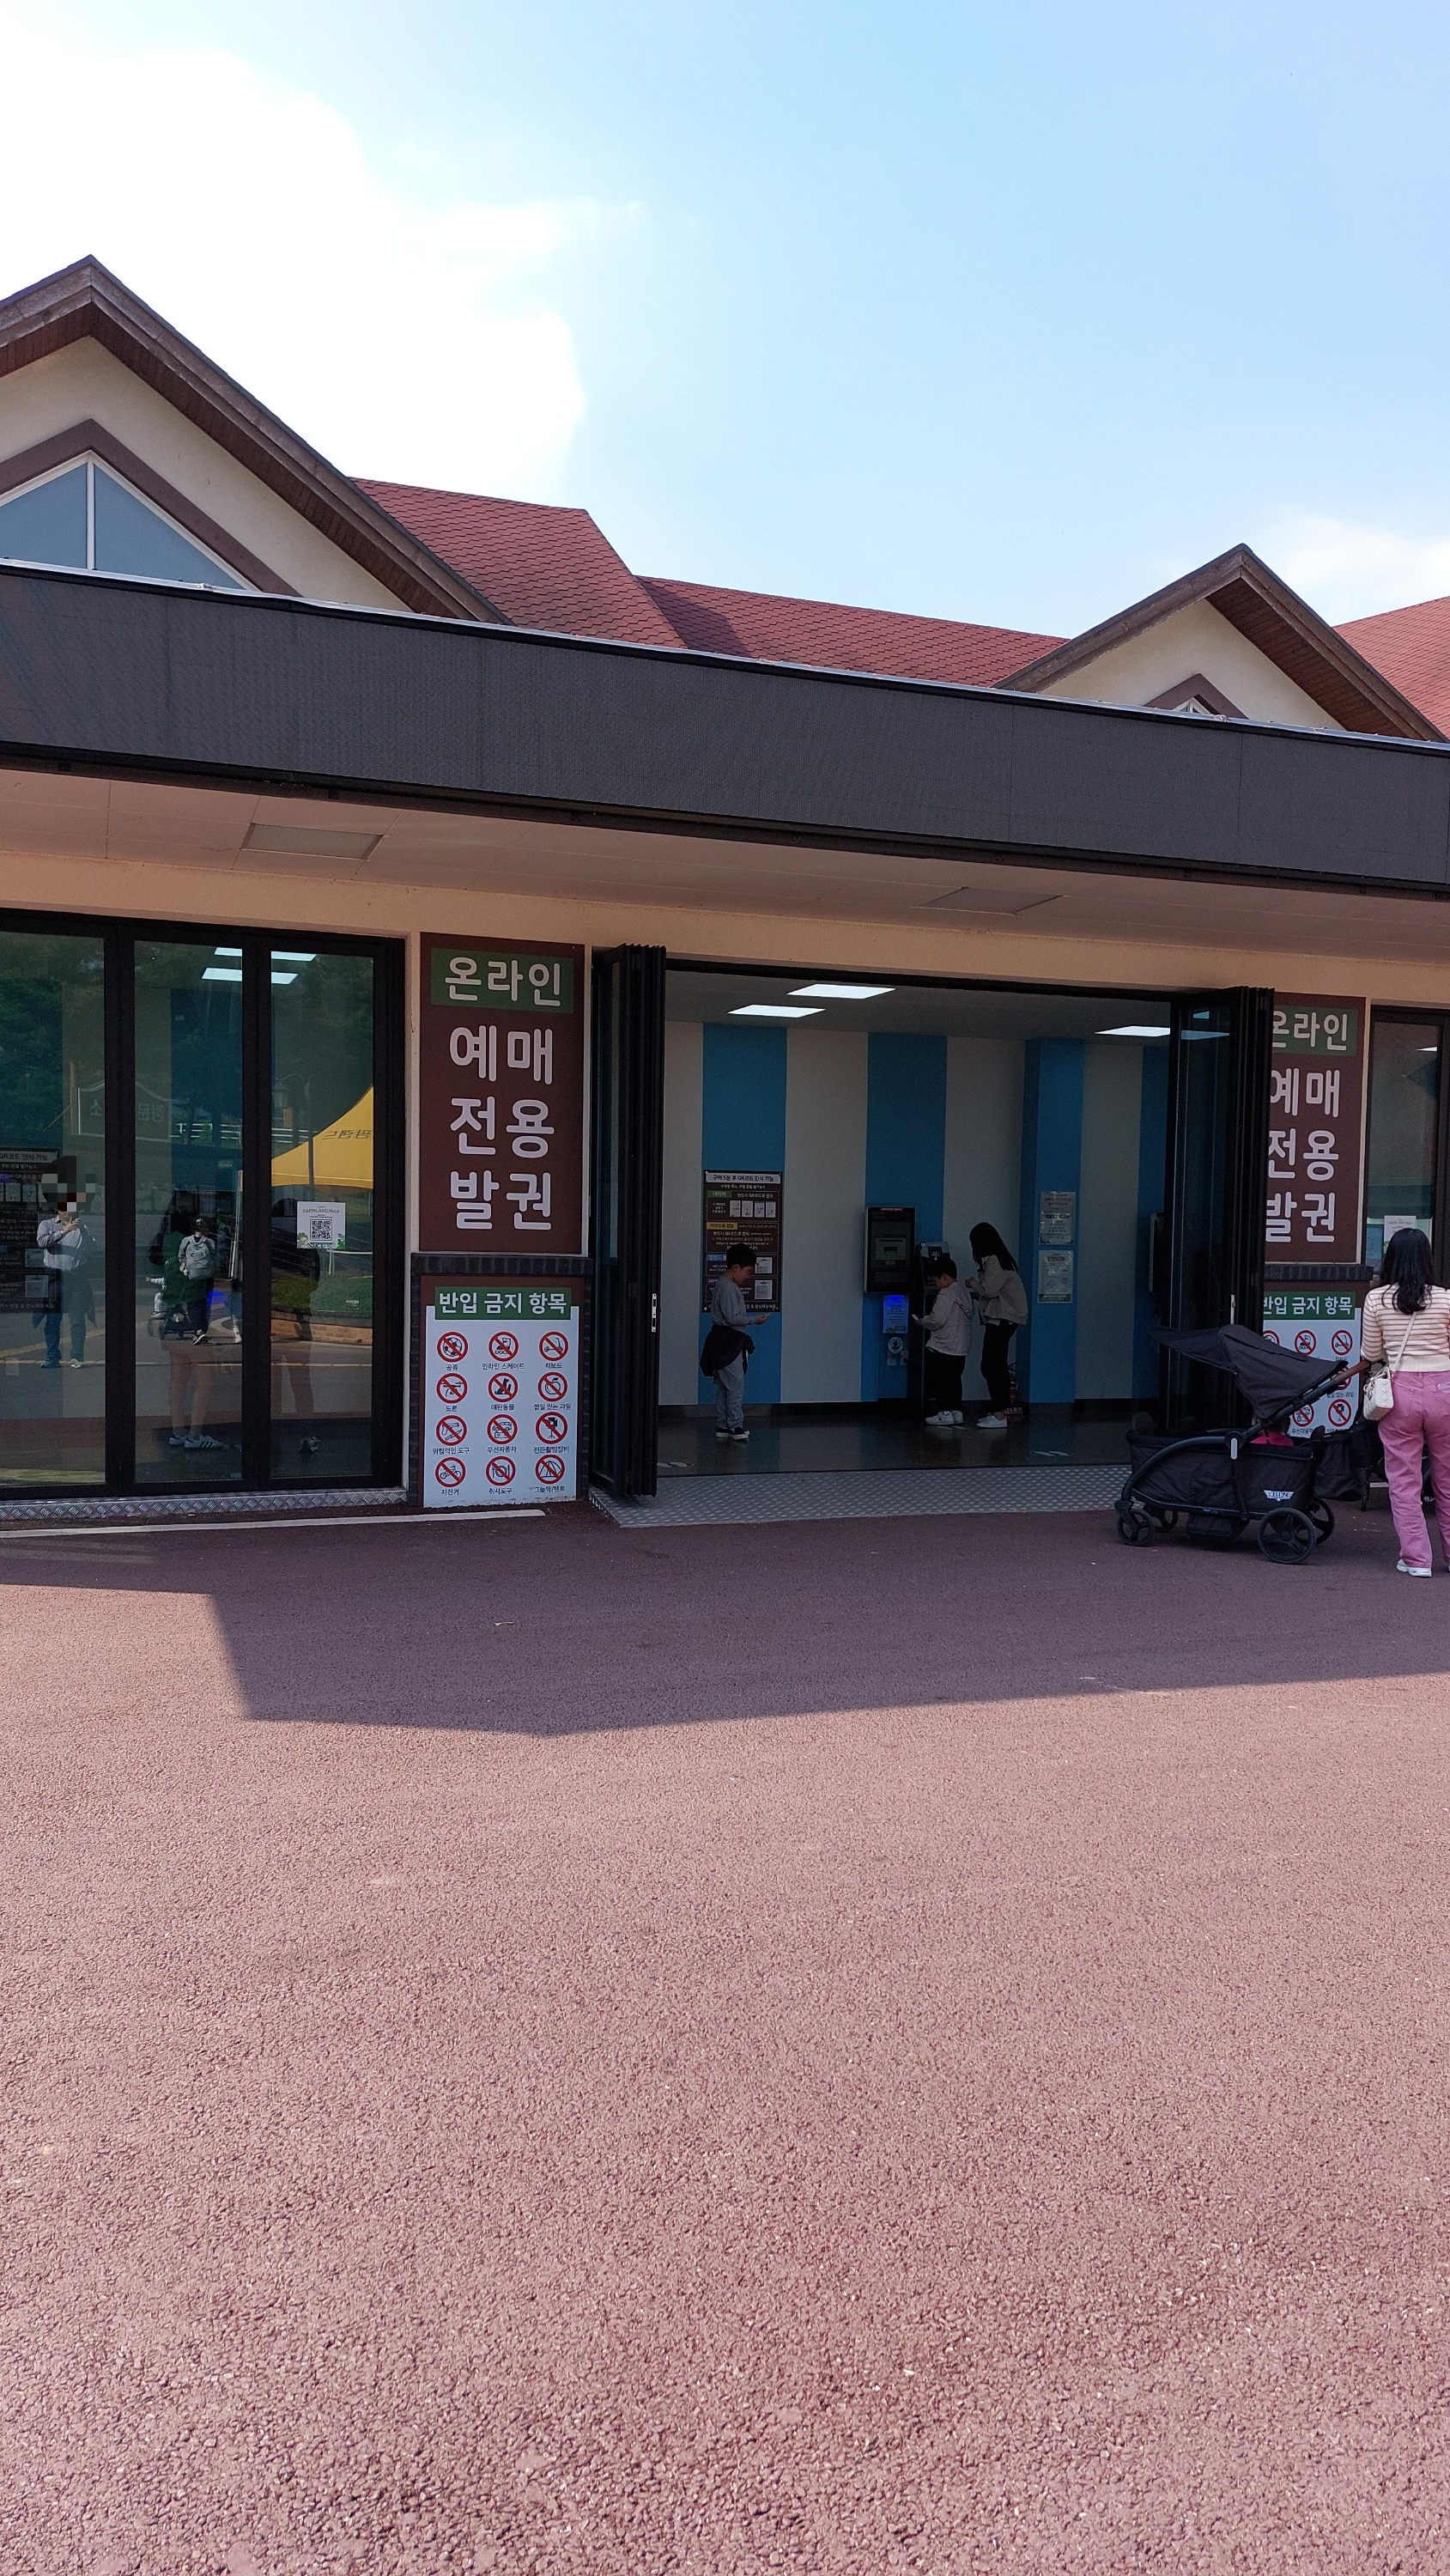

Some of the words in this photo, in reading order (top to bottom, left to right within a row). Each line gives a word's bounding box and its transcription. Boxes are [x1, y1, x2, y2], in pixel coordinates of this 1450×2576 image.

[445, 957, 561, 1006] 온라인
[449, 1025, 553, 1084] 예매
[1272, 1010, 1347, 1051] 온라인
[1271, 1068, 1340, 1118] 예매
[450, 1096, 555, 1158] 전용
[1268, 1128, 1339, 1182] 전용
[451, 1170, 552, 1230] 발권
[1265, 1192, 1336, 1242] 발권
[440, 1292, 477, 1313] 반입
[484, 1292, 522, 1314] 금지
[529, 1292, 567, 1314] 항목
[1263, 1297, 1287, 1315] 반입
[1292, 1297, 1320, 1315] 금지
[1325, 1297, 1353, 1315] 항목
[490, 1403, 515, 1412] 애완동물
[547, 1403, 559, 1412] 있는
[486, 1445, 518, 1455] 무선자동차
